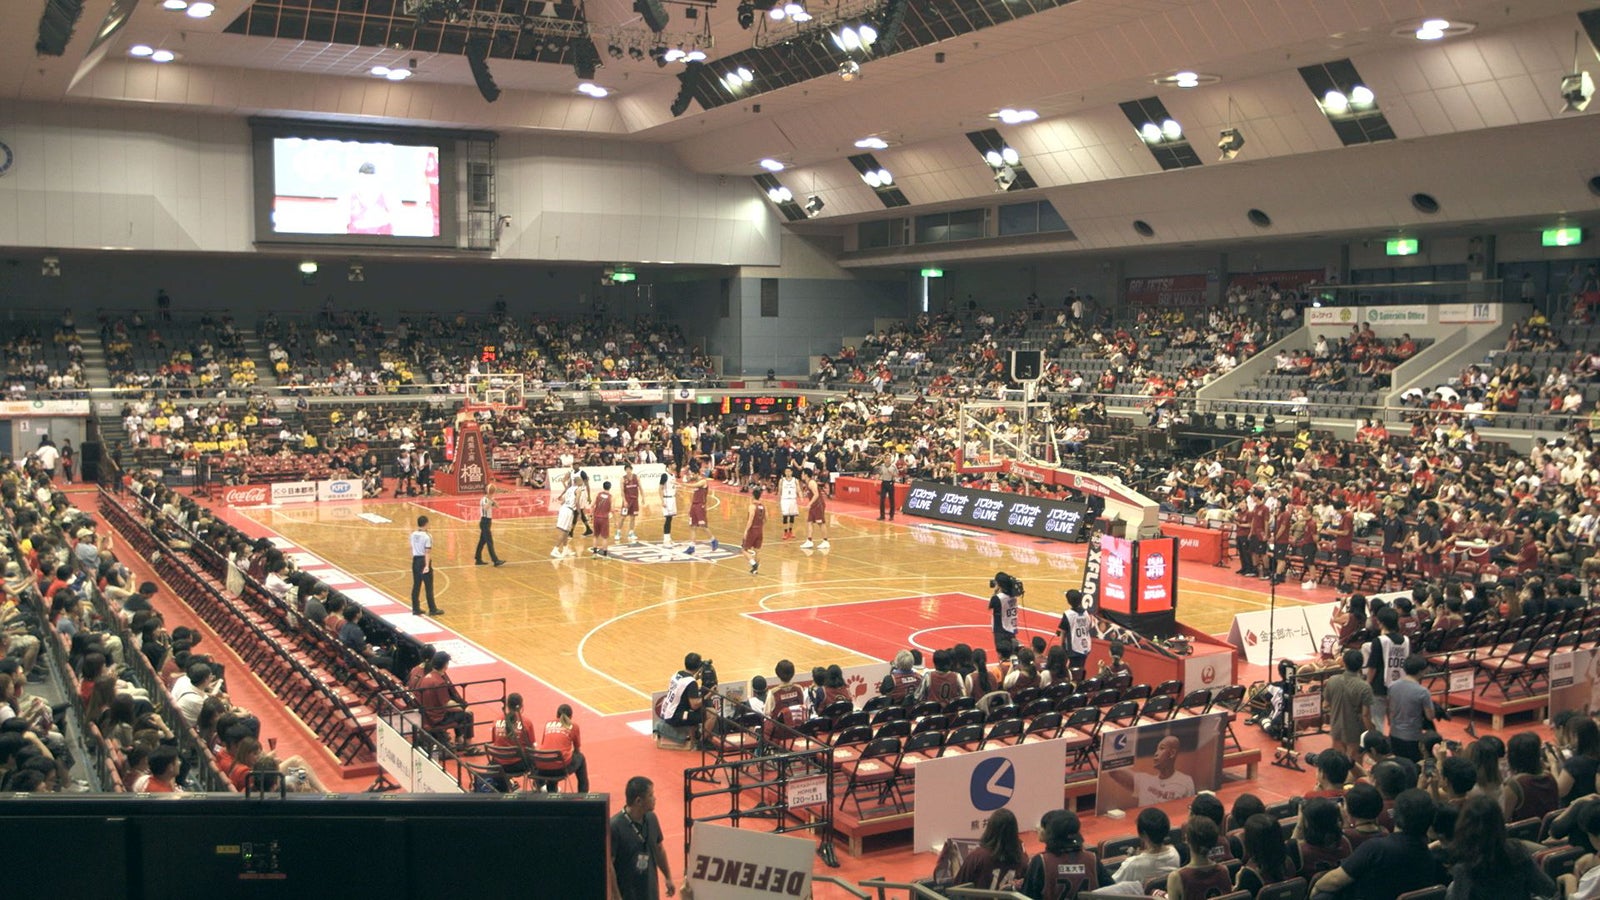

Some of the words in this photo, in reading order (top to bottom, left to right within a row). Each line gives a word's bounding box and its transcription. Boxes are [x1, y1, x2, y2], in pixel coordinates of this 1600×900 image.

[482, 353, 496, 362] 24
[910, 488, 938, 499] バスケット
[941, 492, 970, 504] バスケット
[915, 498, 933, 511] LIVE
[946, 503, 964, 516] LIVE
[974, 497, 1004, 511] バスケット
[1010, 503, 1041, 516] バスケット
[979, 509, 999, 521] LIVE
[1015, 514, 1036, 528] LIVE
[1046, 508, 1081, 521] バスケット
[1053, 520, 1075, 534] LIVE
[1081, 549, 1103, 610] XFLAG
[692, 854, 806, 896] DEFENCE
